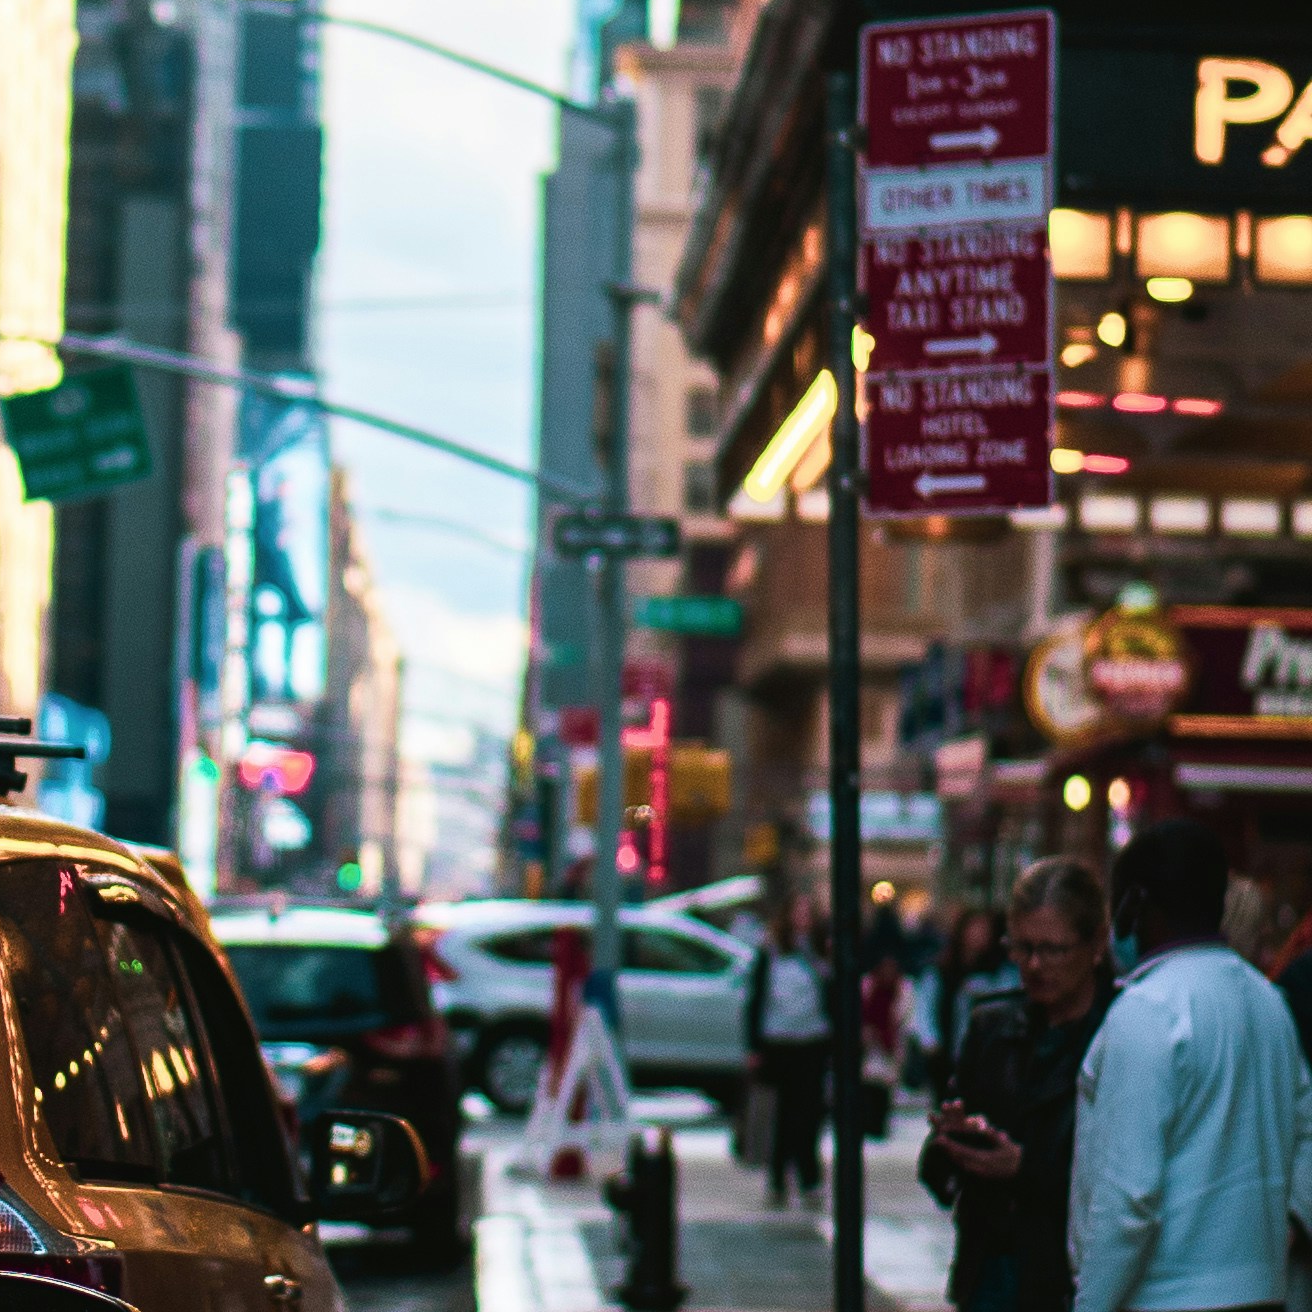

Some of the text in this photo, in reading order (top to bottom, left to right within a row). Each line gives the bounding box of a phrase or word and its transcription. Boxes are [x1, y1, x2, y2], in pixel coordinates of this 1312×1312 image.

[876, 25, 1036, 67] NO STANDING
[881, 178, 1029, 212] OTHER TIMES
[874, 231, 1035, 265] NO STANDING
[896, 262, 1014, 296] ANYTIME
[888, 293, 1024, 330] TAXI STAND
[881, 375, 1032, 411] NO STANDING
[921, 412, 988, 437] HOTEL
[885, 439, 1027, 469] LOADING ZONE
